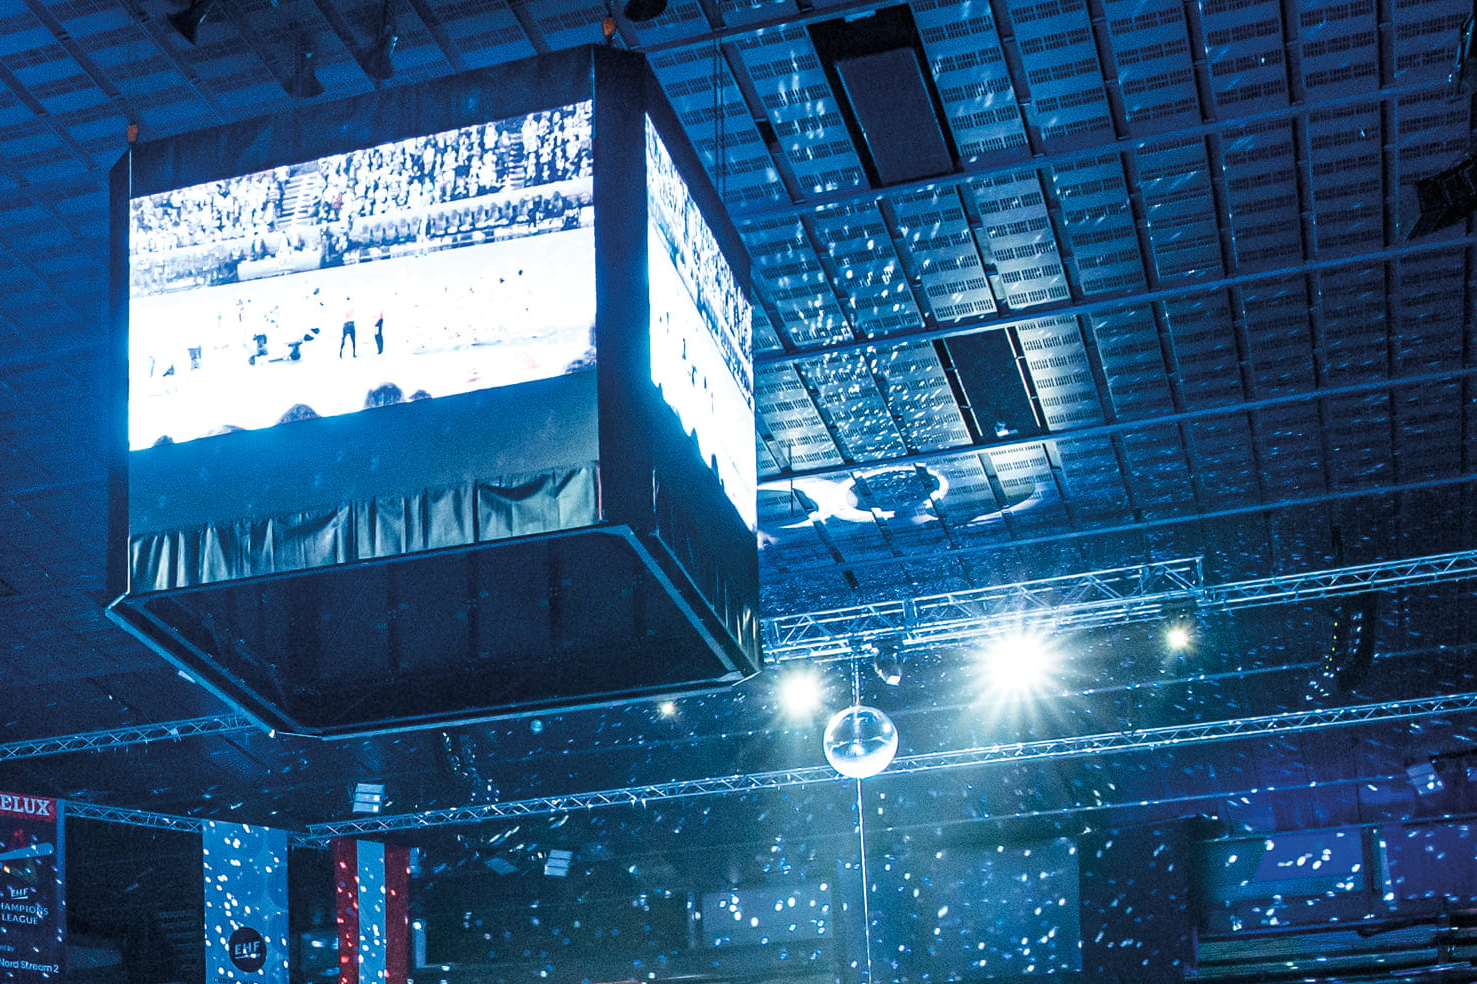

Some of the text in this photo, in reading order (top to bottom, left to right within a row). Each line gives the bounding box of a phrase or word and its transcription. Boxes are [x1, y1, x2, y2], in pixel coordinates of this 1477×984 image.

[1, 914, 39, 925] LEAGUE
[234, 941, 262, 955] EHF
[21, 961, 53, 973] Stream
[53, 964, 60, 974] 2
